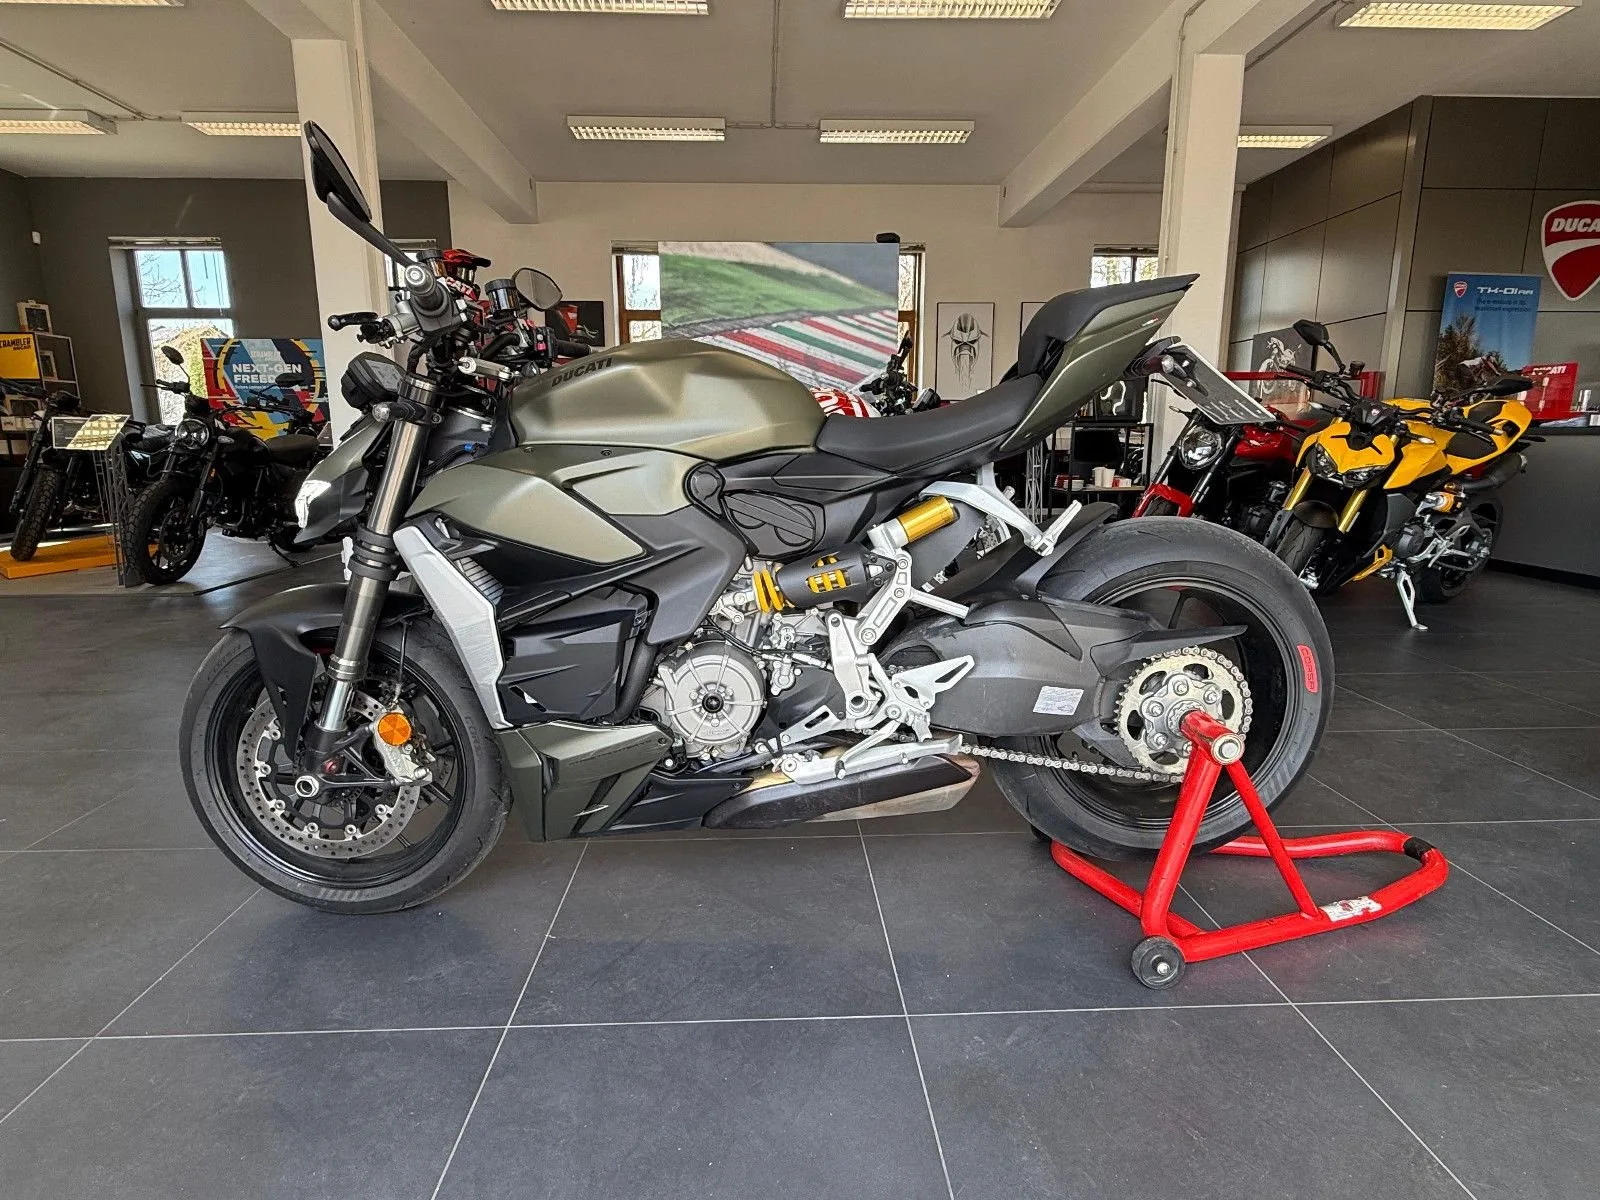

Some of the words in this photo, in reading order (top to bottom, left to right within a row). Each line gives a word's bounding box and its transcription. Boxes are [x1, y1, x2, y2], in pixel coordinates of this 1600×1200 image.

[232, 363, 302, 373] NEXT-GEN
[552, 357, 613, 387] DUCATI
[234, 374, 276, 384] FREED
[1301, 648, 1315, 690] CORSA
